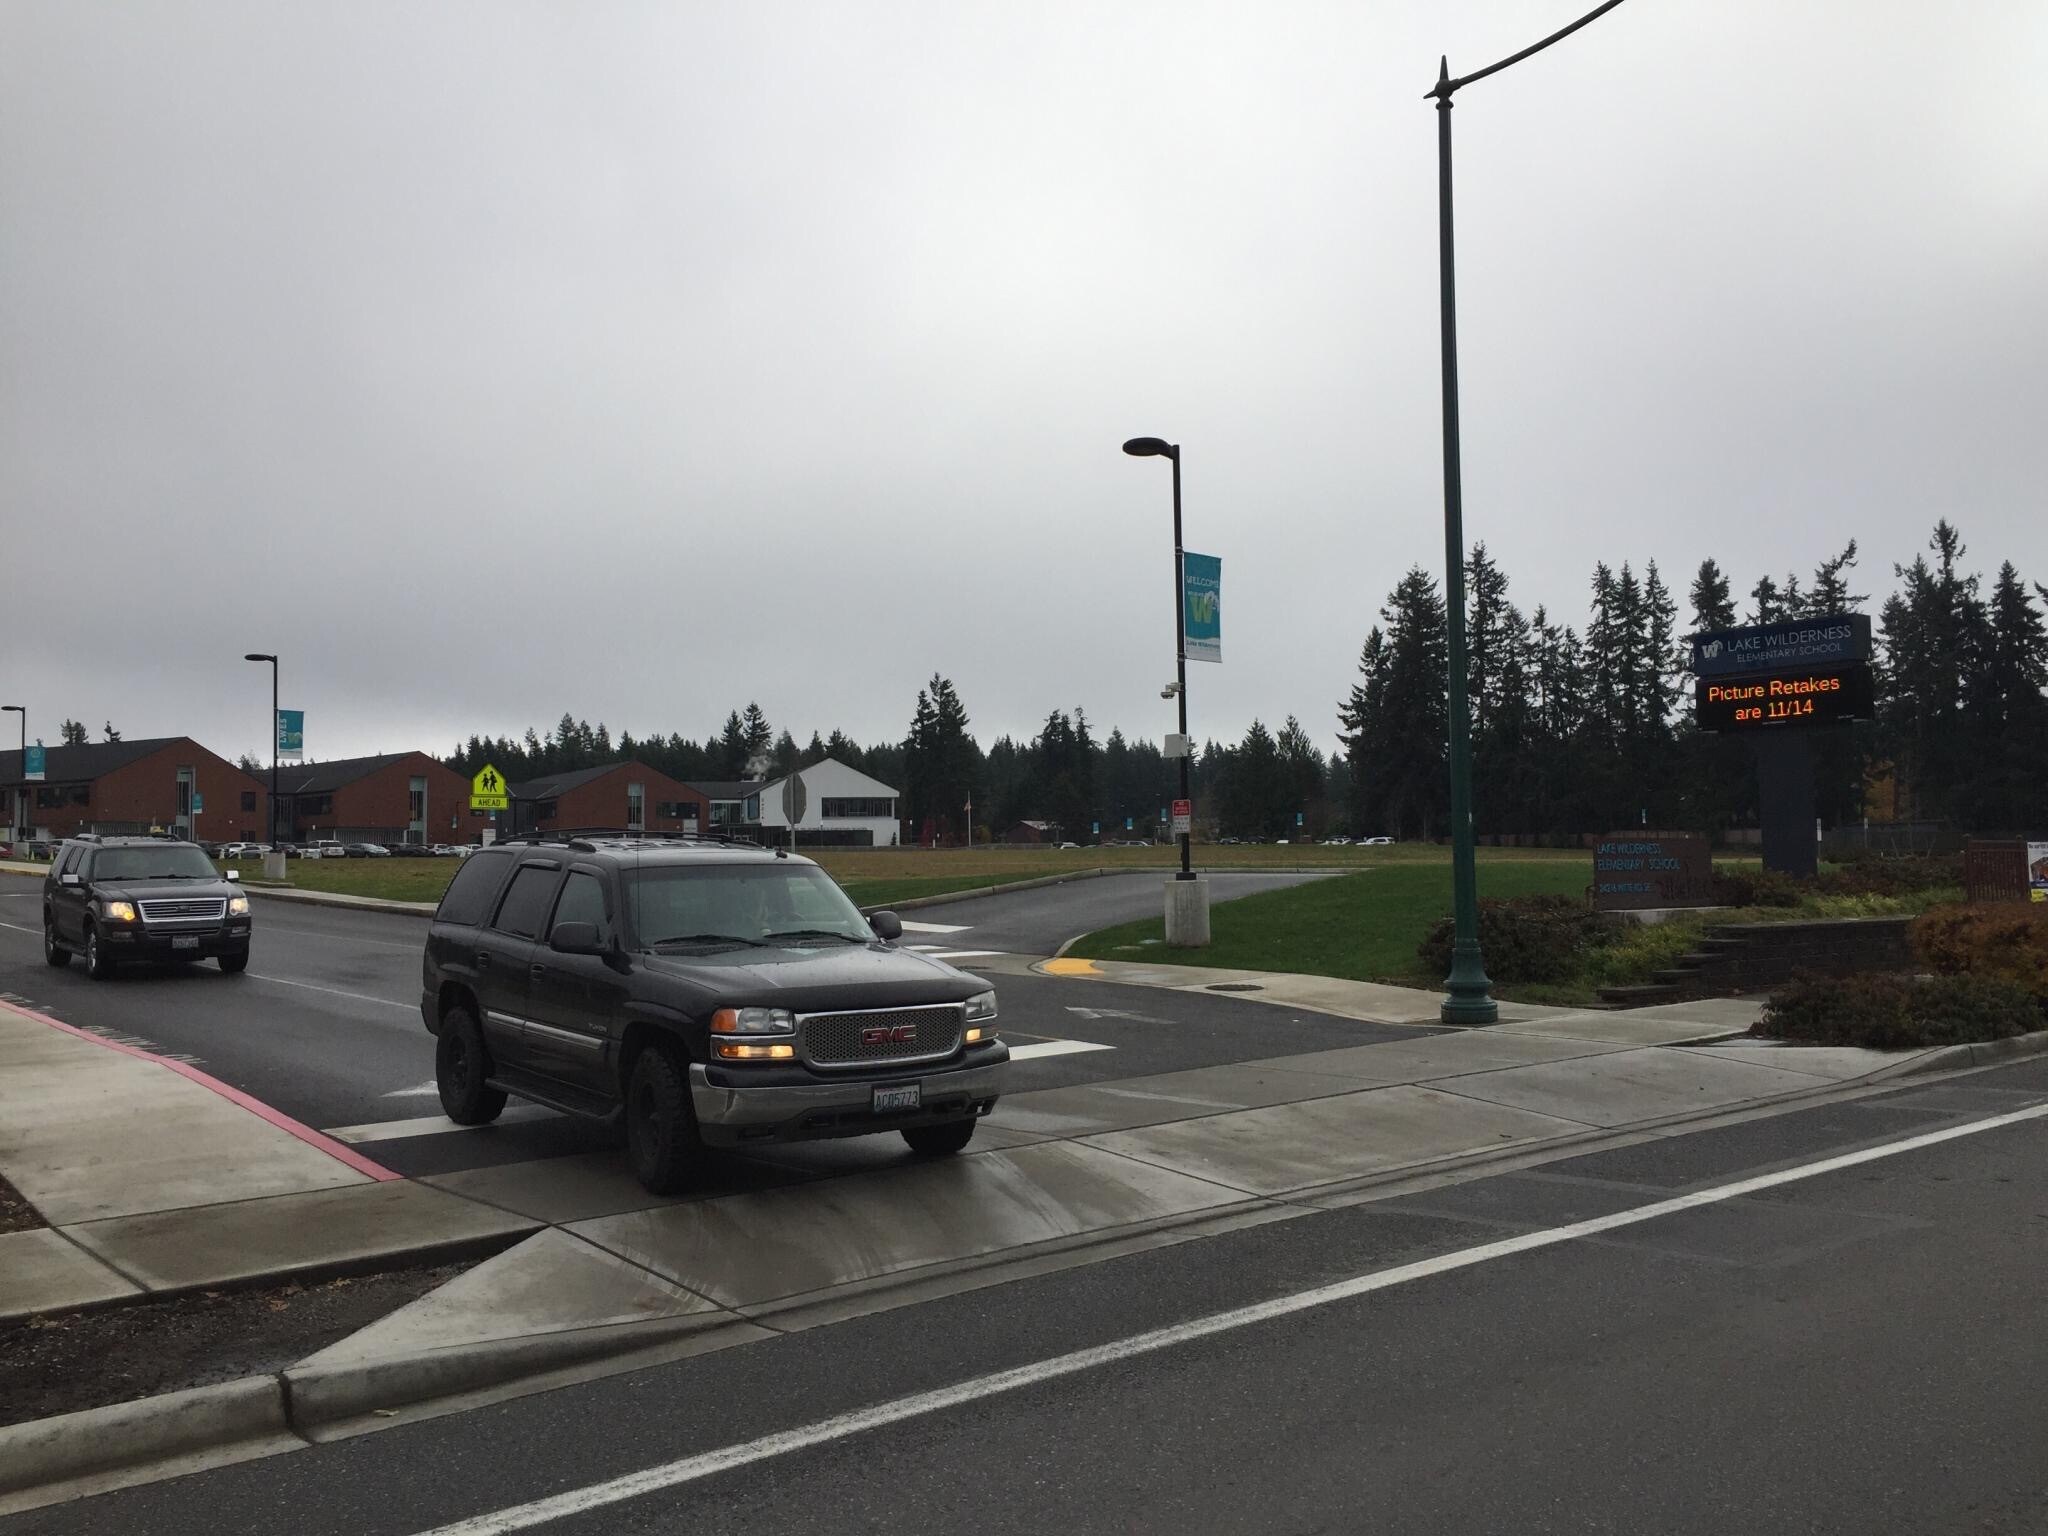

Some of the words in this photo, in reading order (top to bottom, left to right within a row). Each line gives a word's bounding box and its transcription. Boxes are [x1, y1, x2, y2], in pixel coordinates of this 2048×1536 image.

[1727, 637, 1761, 652] LAKE
[1764, 625, 1851, 646] WILDERNESS
[1737, 648, 1797, 663] ELEMENTARY
[1798, 643, 1842, 656] SCHOOL
[1709, 685, 1765, 702] Picture
[1769, 677, 1840, 696] Retakes
[1735, 707, 1761, 720] are
[1768, 699, 1814, 717] 11/14
[478, 799, 500, 807] AHEAD
[1597, 843, 1616, 854] LAKE
[1617, 843, 1661, 854] WILDERNESS
[1597, 859, 1644, 871] ELEMENTARY
[1648, 858, 1680, 870] SCHOOL
[862, 1024, 916, 1045] GMC
